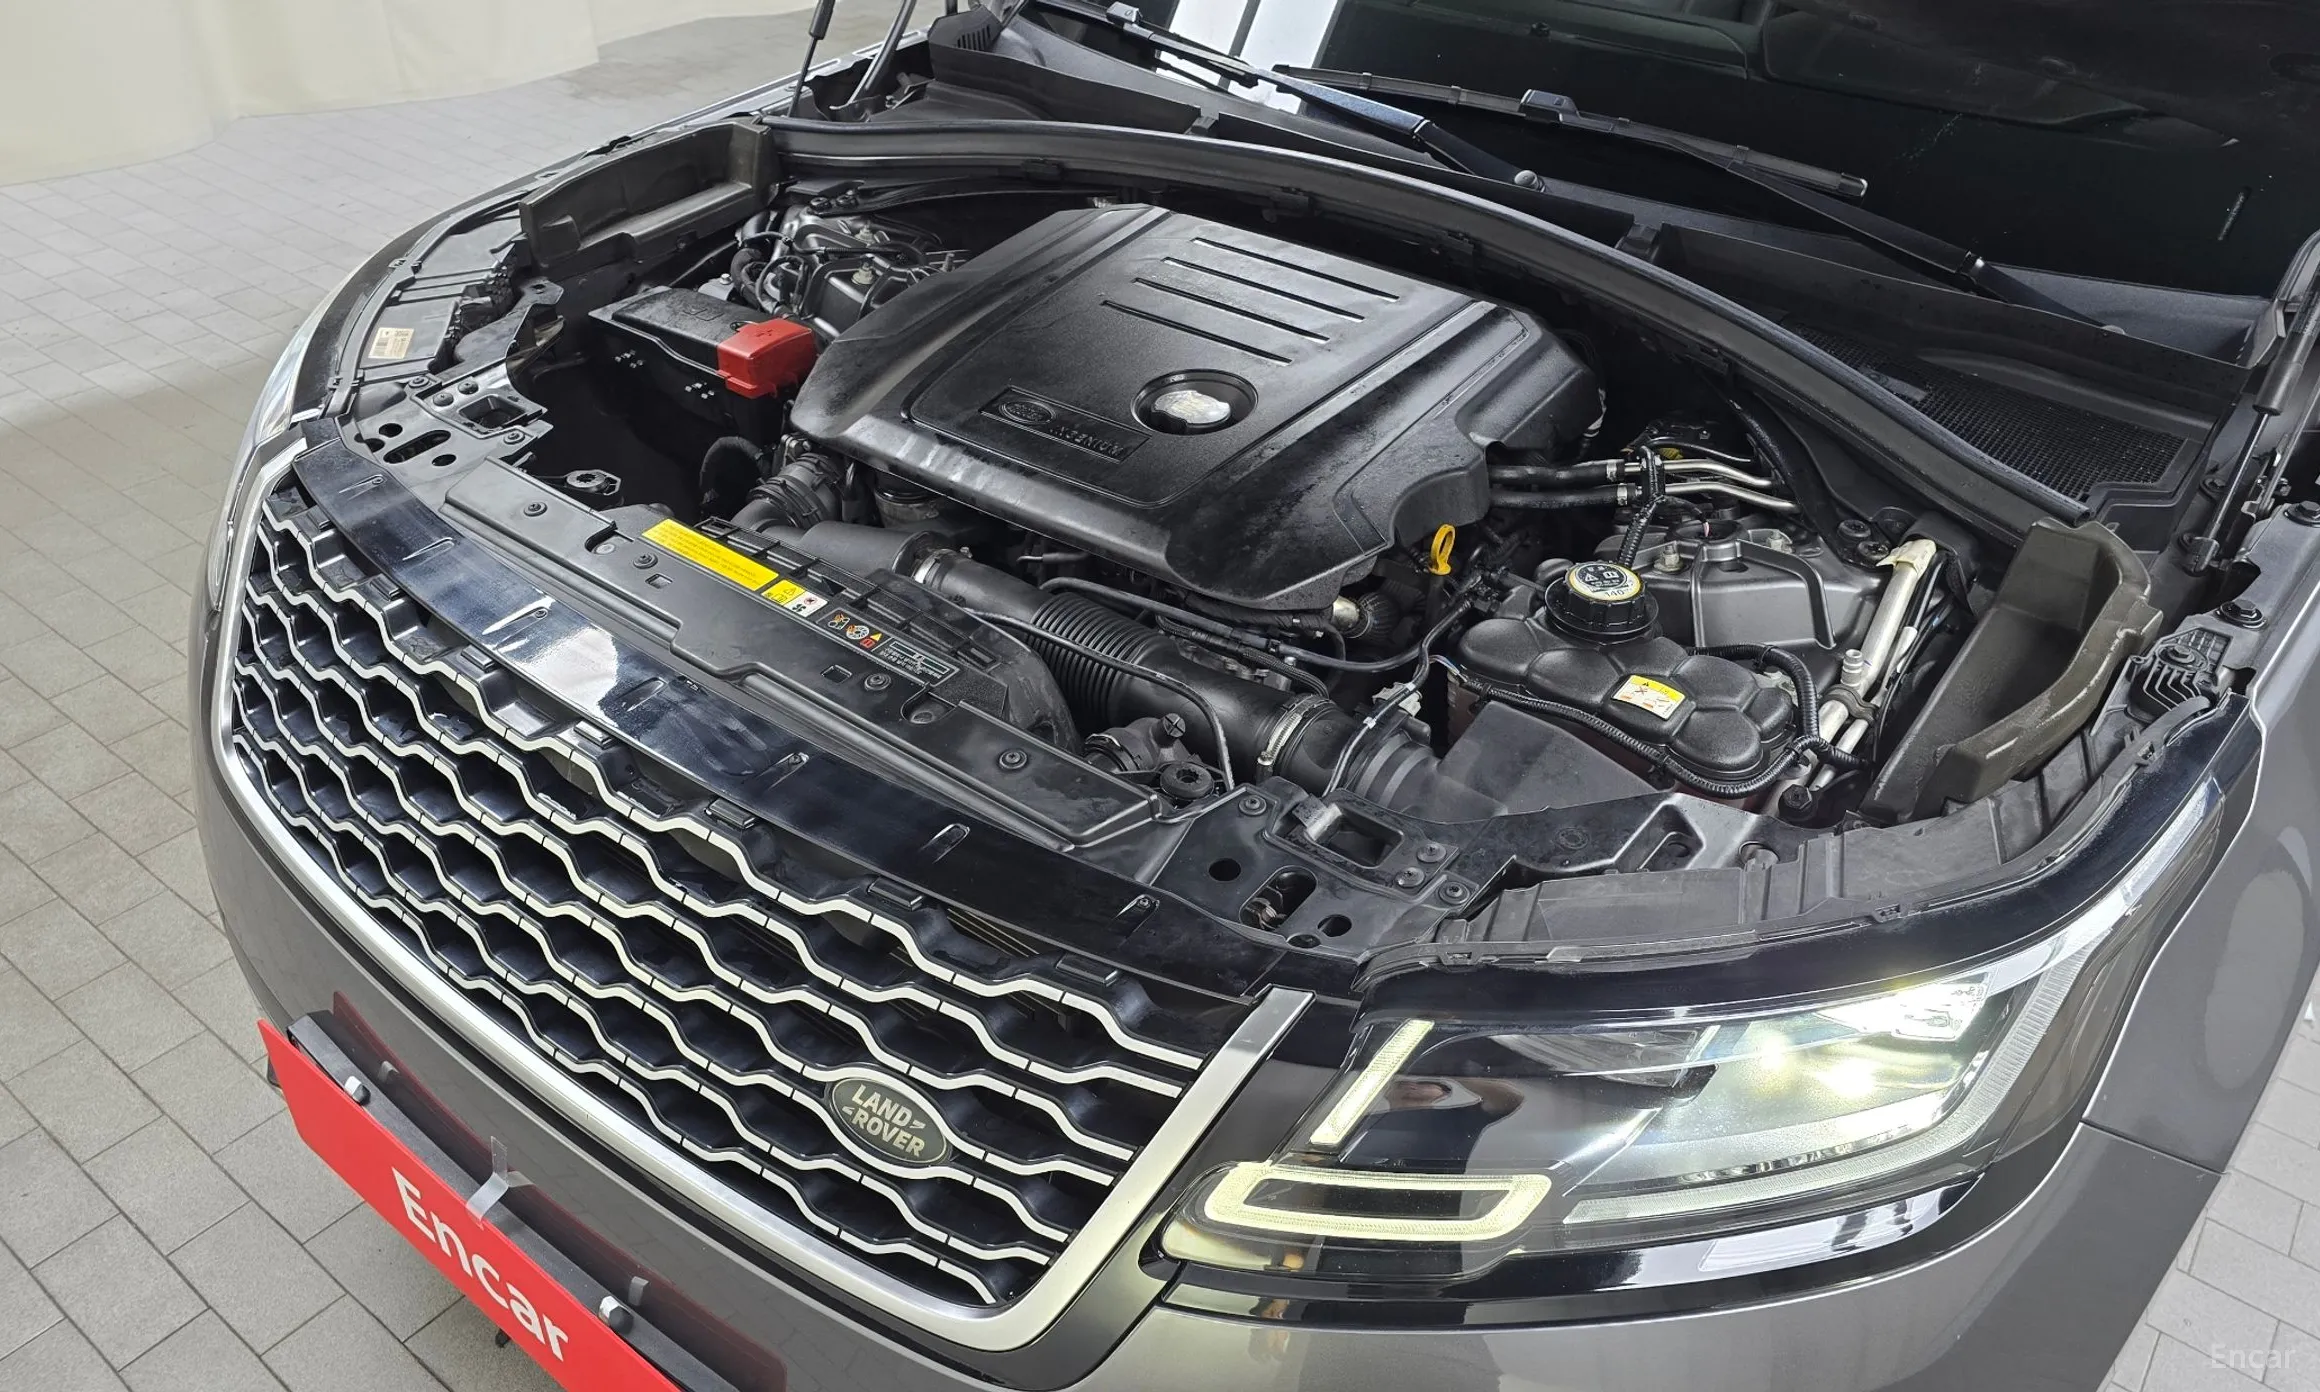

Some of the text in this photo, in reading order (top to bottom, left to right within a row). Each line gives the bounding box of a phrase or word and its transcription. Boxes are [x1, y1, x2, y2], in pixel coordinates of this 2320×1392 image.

[851, 1083, 913, 1127] LAND
[852, 1107, 925, 1158] ROVER
[391, 1166, 569, 1362] Encar
